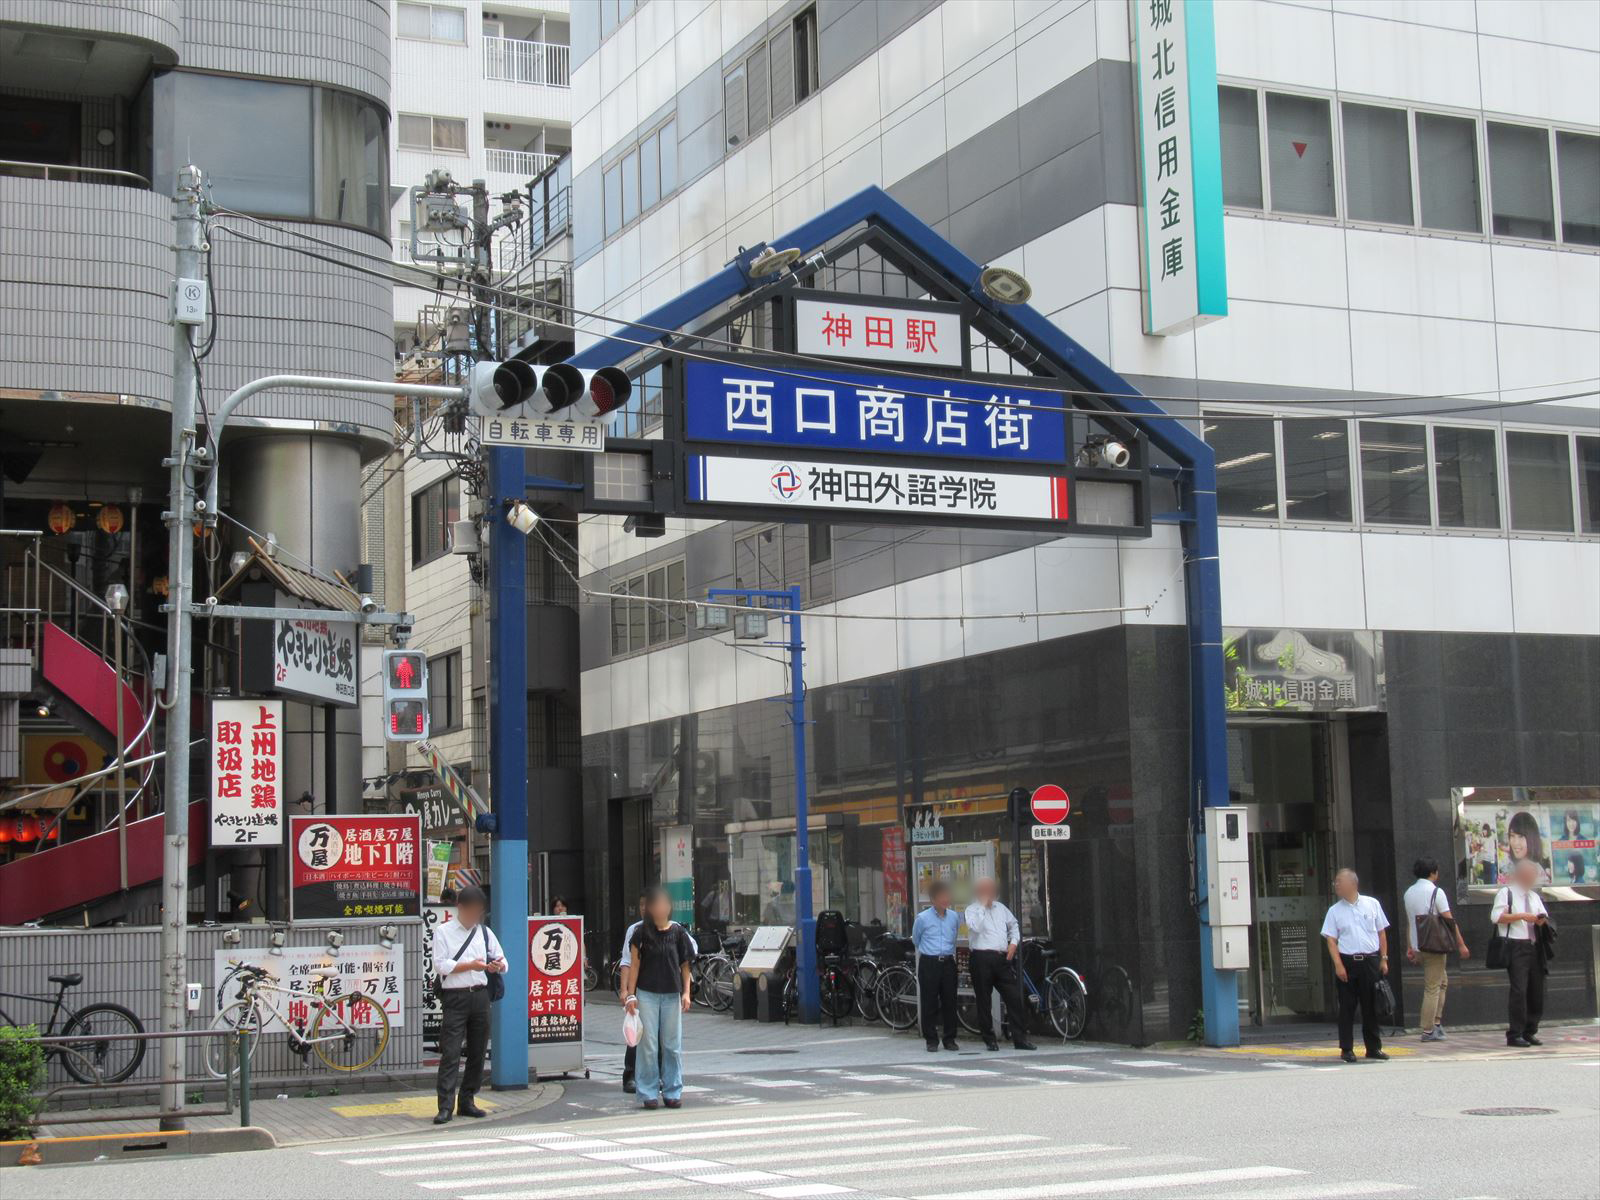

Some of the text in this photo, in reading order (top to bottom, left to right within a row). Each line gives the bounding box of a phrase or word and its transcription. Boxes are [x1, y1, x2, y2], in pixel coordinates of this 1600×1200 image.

[1149, 0, 1184, 283] 城北信用金庫
[821, 311, 938, 354] 神田駅
[722, 377, 1034, 450] 西口商店街
[489, 419, 599, 446] 自転車専用
[808, 466, 997, 511] 神田外語学院
[276, 663, 287, 682] 2F
[1244, 679, 1357, 702] 城北信用金庫
[216, 720, 243, 798] 取扱店
[250, 705, 277, 809] 上州地鶏
[215, 812, 278, 827] やきとり道場
[234, 828, 259, 843] 2F
[309, 825, 331, 867] 万屋
[344, 827, 414, 842] 居酒屋万屋
[344, 842, 414, 865] 地下1階
[542, 927, 563, 971] 万屋
[363, 976, 399, 995] 万屋
[529, 978, 580, 997] 居酒屋
[531, 998, 577, 1012] 地下1階
